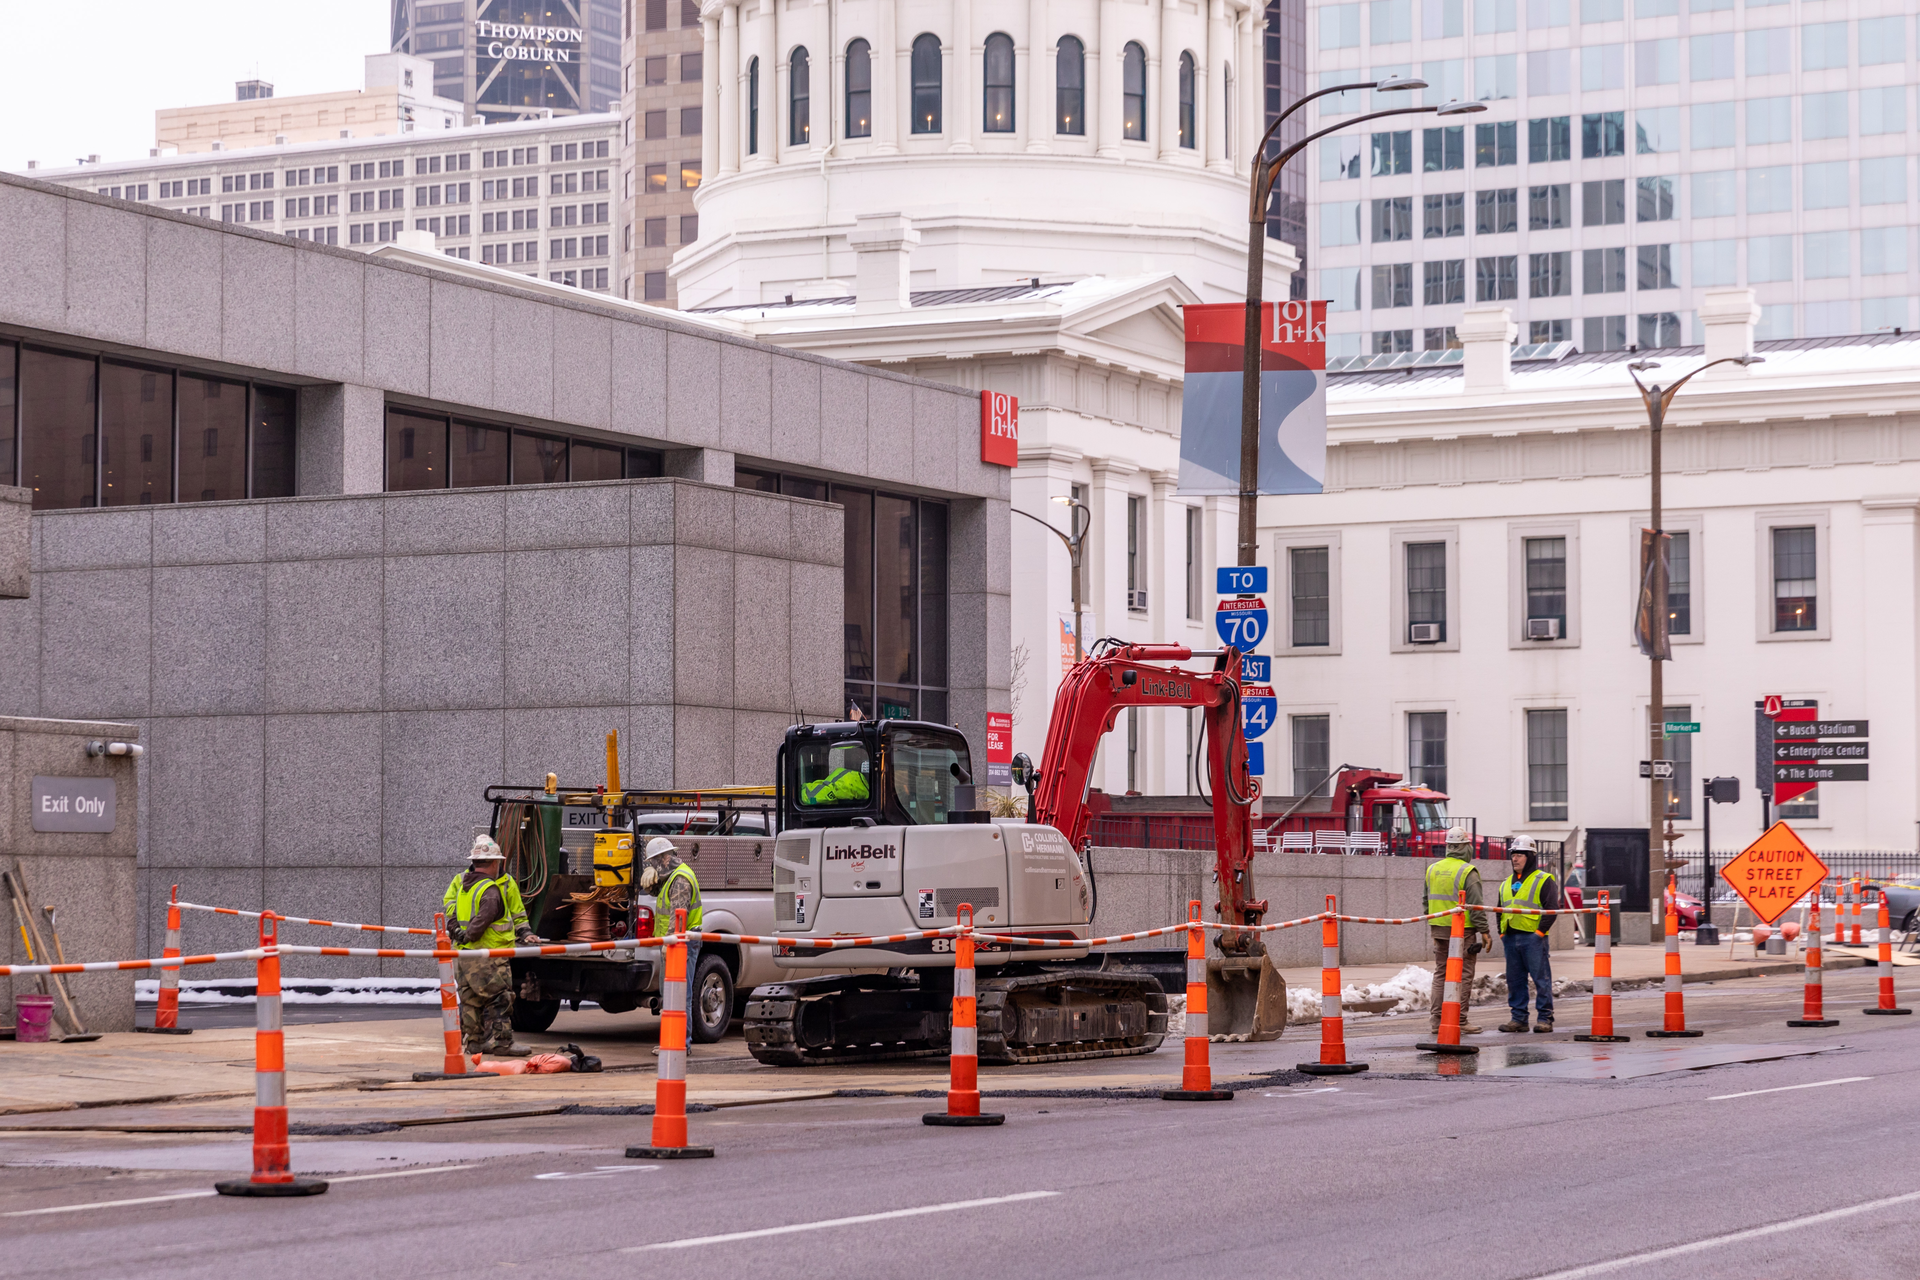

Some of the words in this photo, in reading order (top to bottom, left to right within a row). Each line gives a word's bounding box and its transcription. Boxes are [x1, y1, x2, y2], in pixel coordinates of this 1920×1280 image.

[475, 20, 583, 43] THOMPSON
[487, 41, 570, 63] COBURN
[1229, 572, 1254, 588] TO
[1223, 600, 1260, 610] INTERSTATE
[1225, 617, 1260, 643] 70
[1141, 677, 1192, 699] Link-Belt
[1241, 688, 1270, 696] ERSTATE
[1666, 724, 1692, 732] Market
[1789, 725, 1816, 736] Busch
[1819, 724, 1856, 735] Stadium
[987, 733, 999, 741] FOR
[987, 741, 1004, 750] LEASE
[1789, 745, 1834, 758] Enterprise
[1836, 745, 1866, 756] Center
[1789, 768, 1806, 778] The
[1808, 768, 1834, 778] Dome
[42, 795, 69, 813] Exit
[75, 796, 106, 817] Only
[569, 813, 598, 826] EXIT
[1034, 833, 1058, 843] COLLINS
[826, 844, 896, 861] Link-Belt
[1035, 844, 1065, 854] HERMANN
[1748, 850, 1805, 863] CAUTION
[1746, 868, 1803, 881] STREET
[1748, 886, 1796, 899] PLATE
